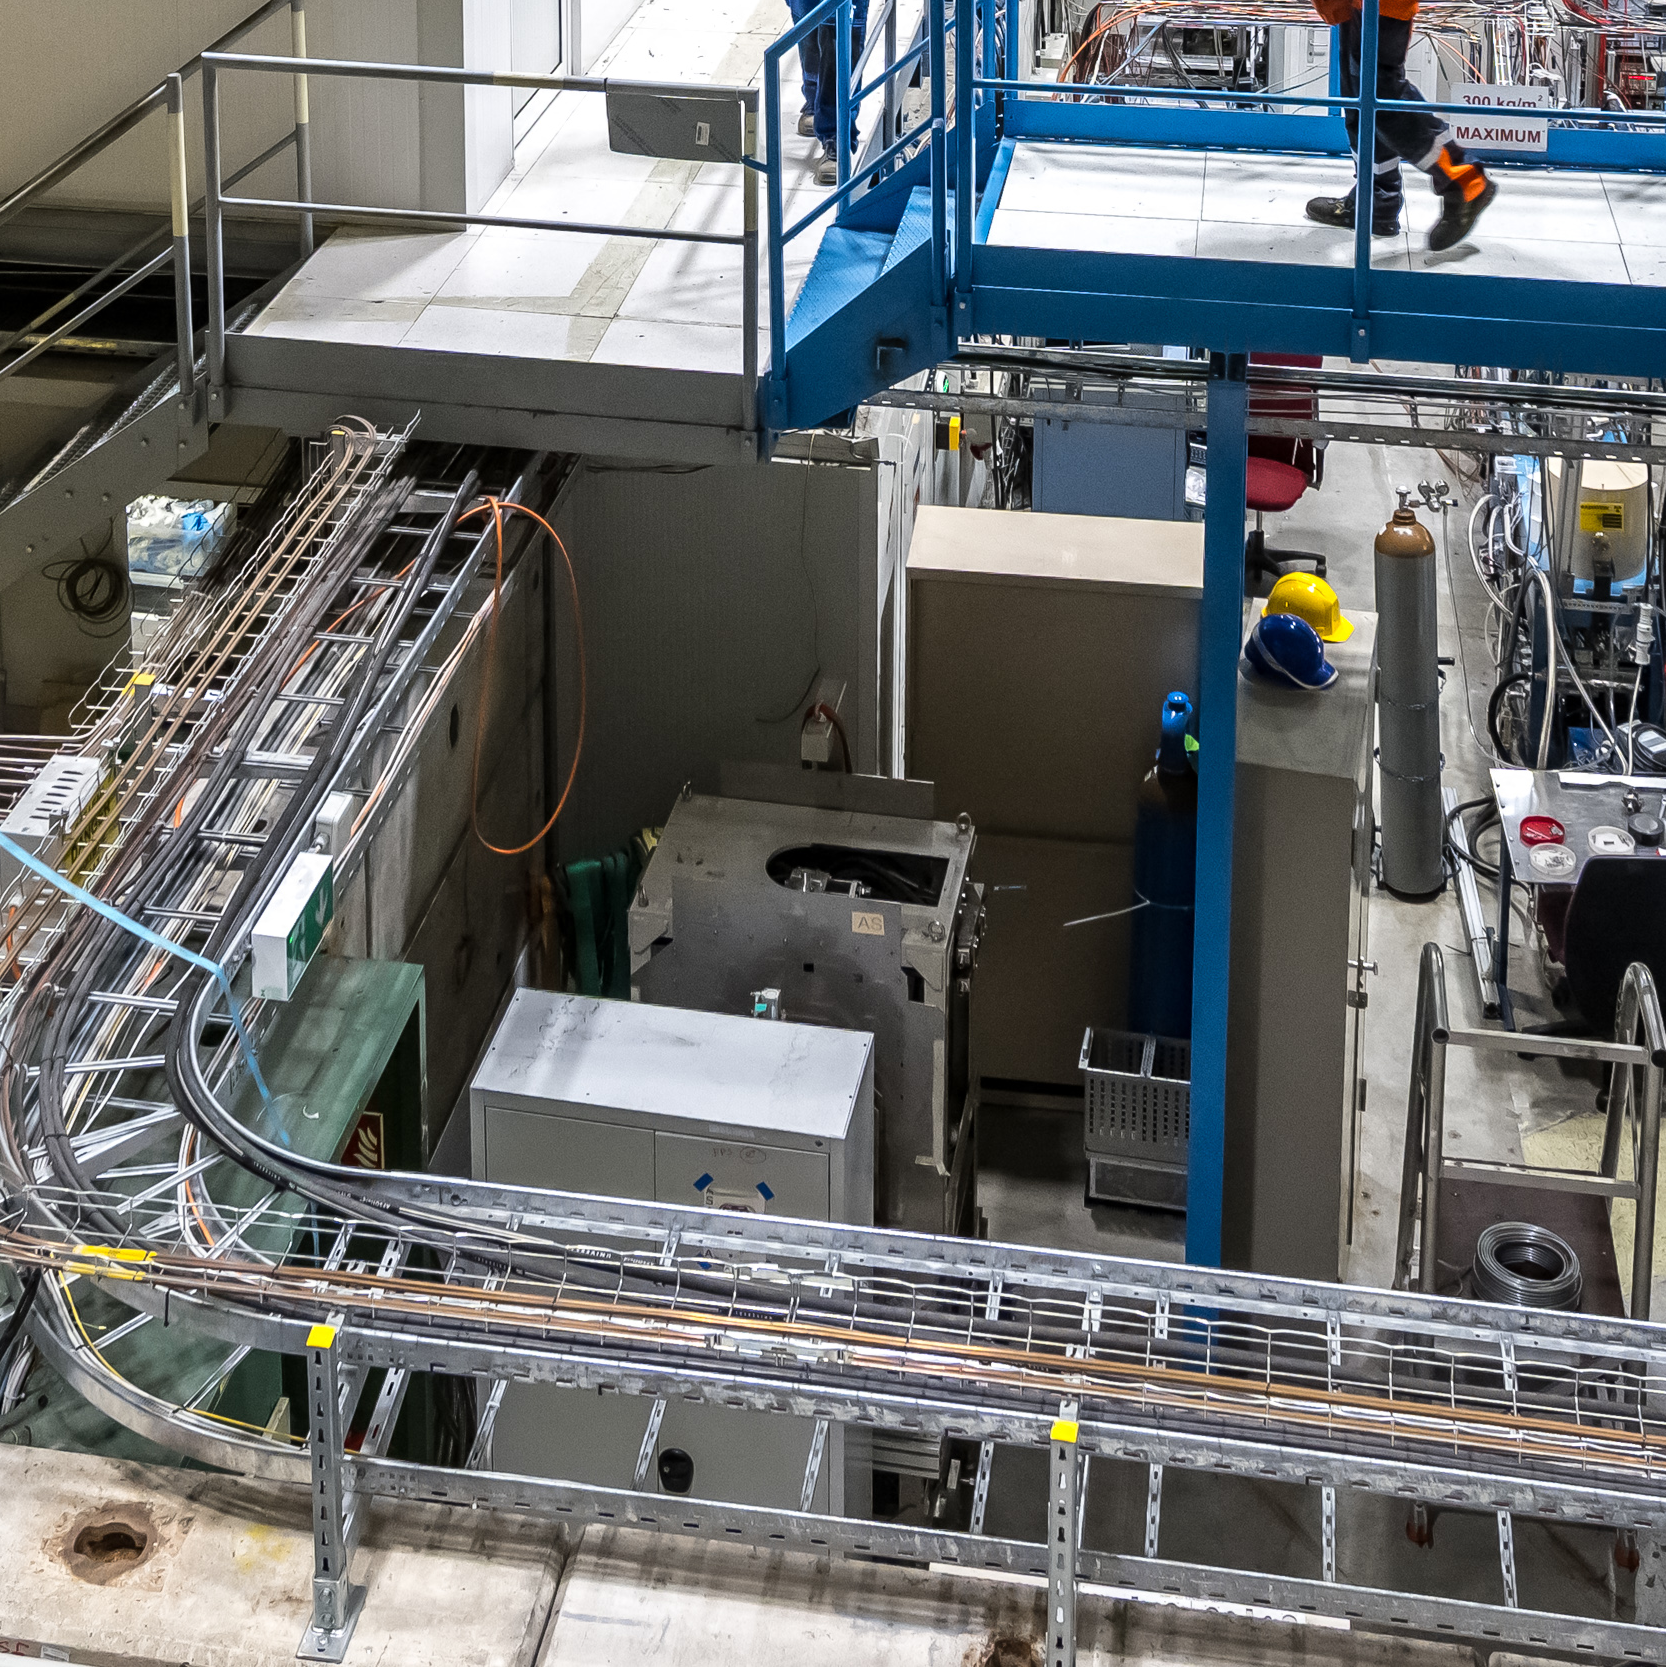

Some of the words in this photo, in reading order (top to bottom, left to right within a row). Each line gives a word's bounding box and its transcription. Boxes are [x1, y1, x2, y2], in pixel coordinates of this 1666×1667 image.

[1463, 95, 1491, 106] 300
[1456, 126, 1541, 143] MAXIMUM
[858, 916, 882, 931] AS
